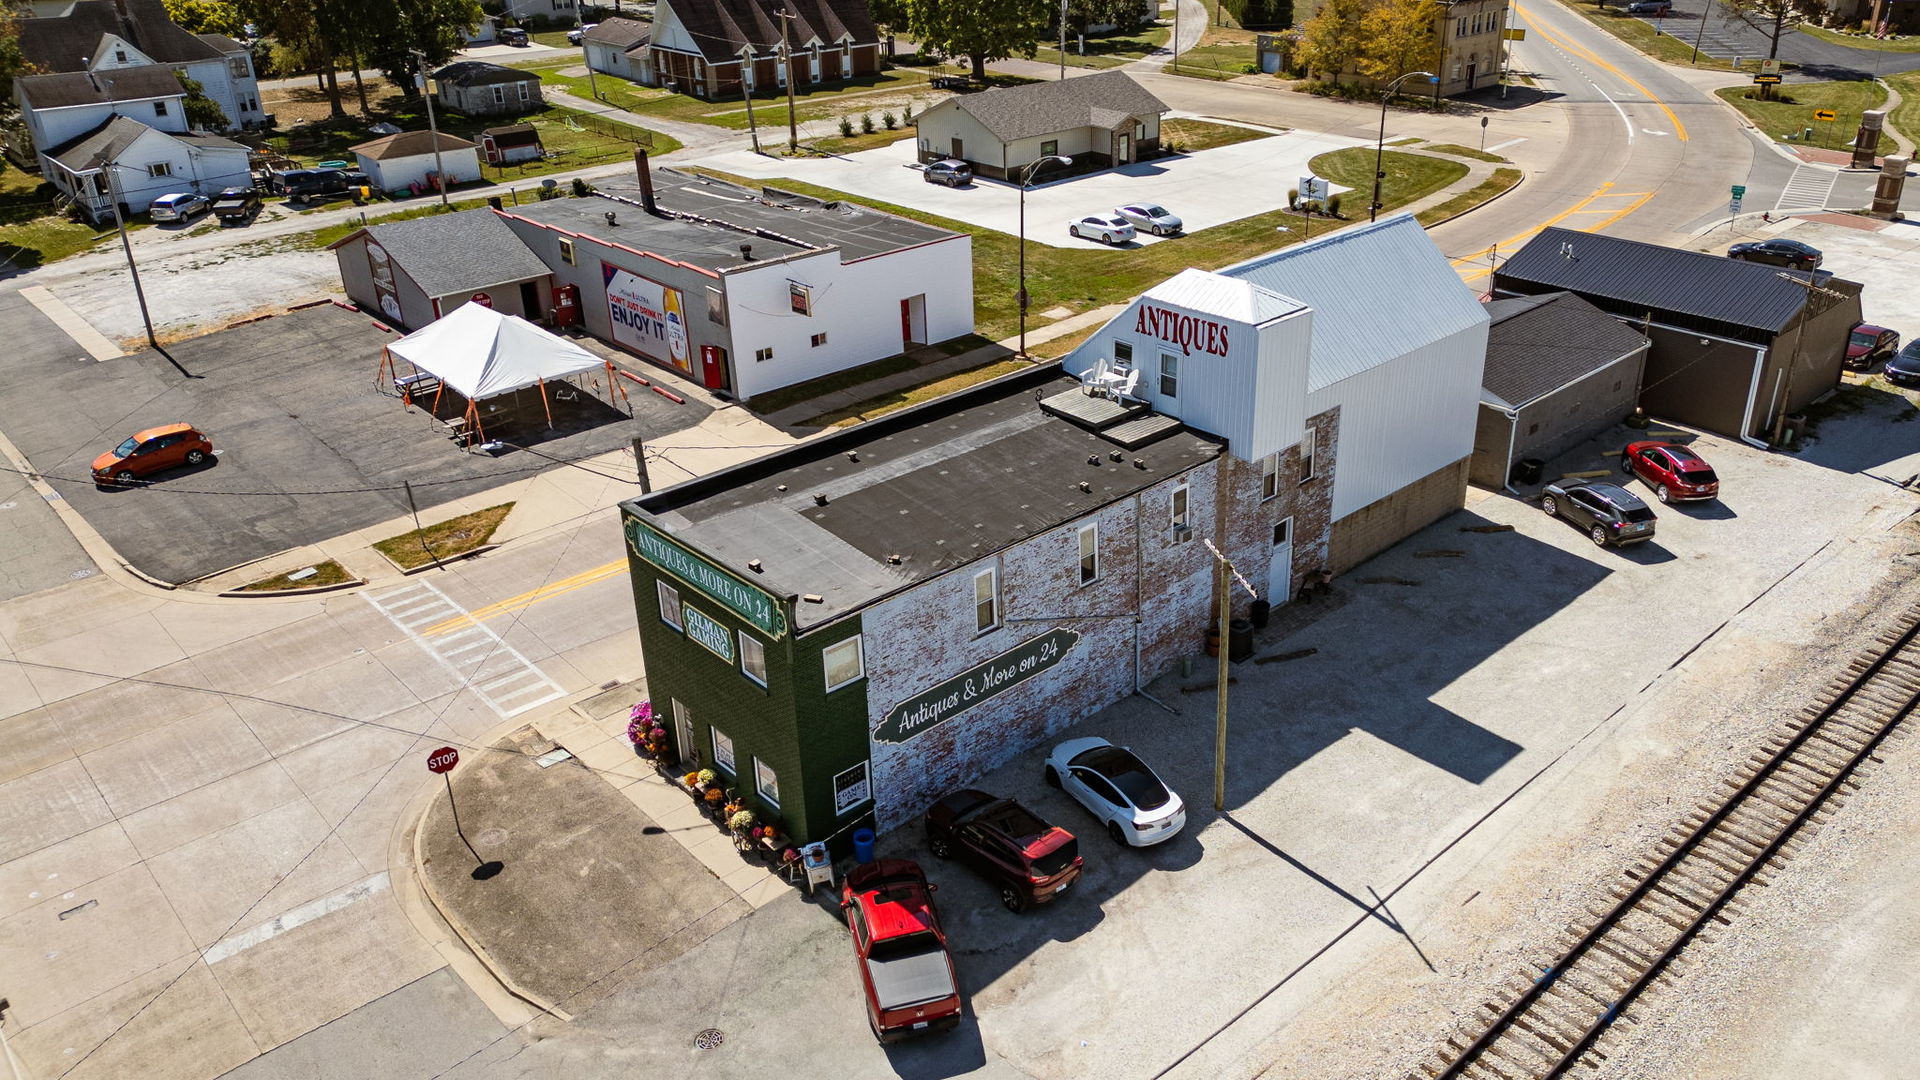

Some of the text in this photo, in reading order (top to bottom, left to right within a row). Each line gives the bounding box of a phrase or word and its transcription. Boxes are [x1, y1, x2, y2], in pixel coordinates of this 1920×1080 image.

[611, 303, 650, 335] ENJOY
[653, 320, 665, 341] IT
[627, 300, 639, 312] JUST
[639, 306, 657, 319] DRINK
[1135, 304, 1229, 357] ANTIQUES
[638, 532, 770, 623] ANTIQUES & MORE ON 24
[686, 608, 729, 644] GILMAN
[688, 622, 730, 659] GAMING
[898, 637, 1059, 734] Antiques & More on 24
[429, 751, 457, 769] STOP
[842, 784, 861, 797] GAME
